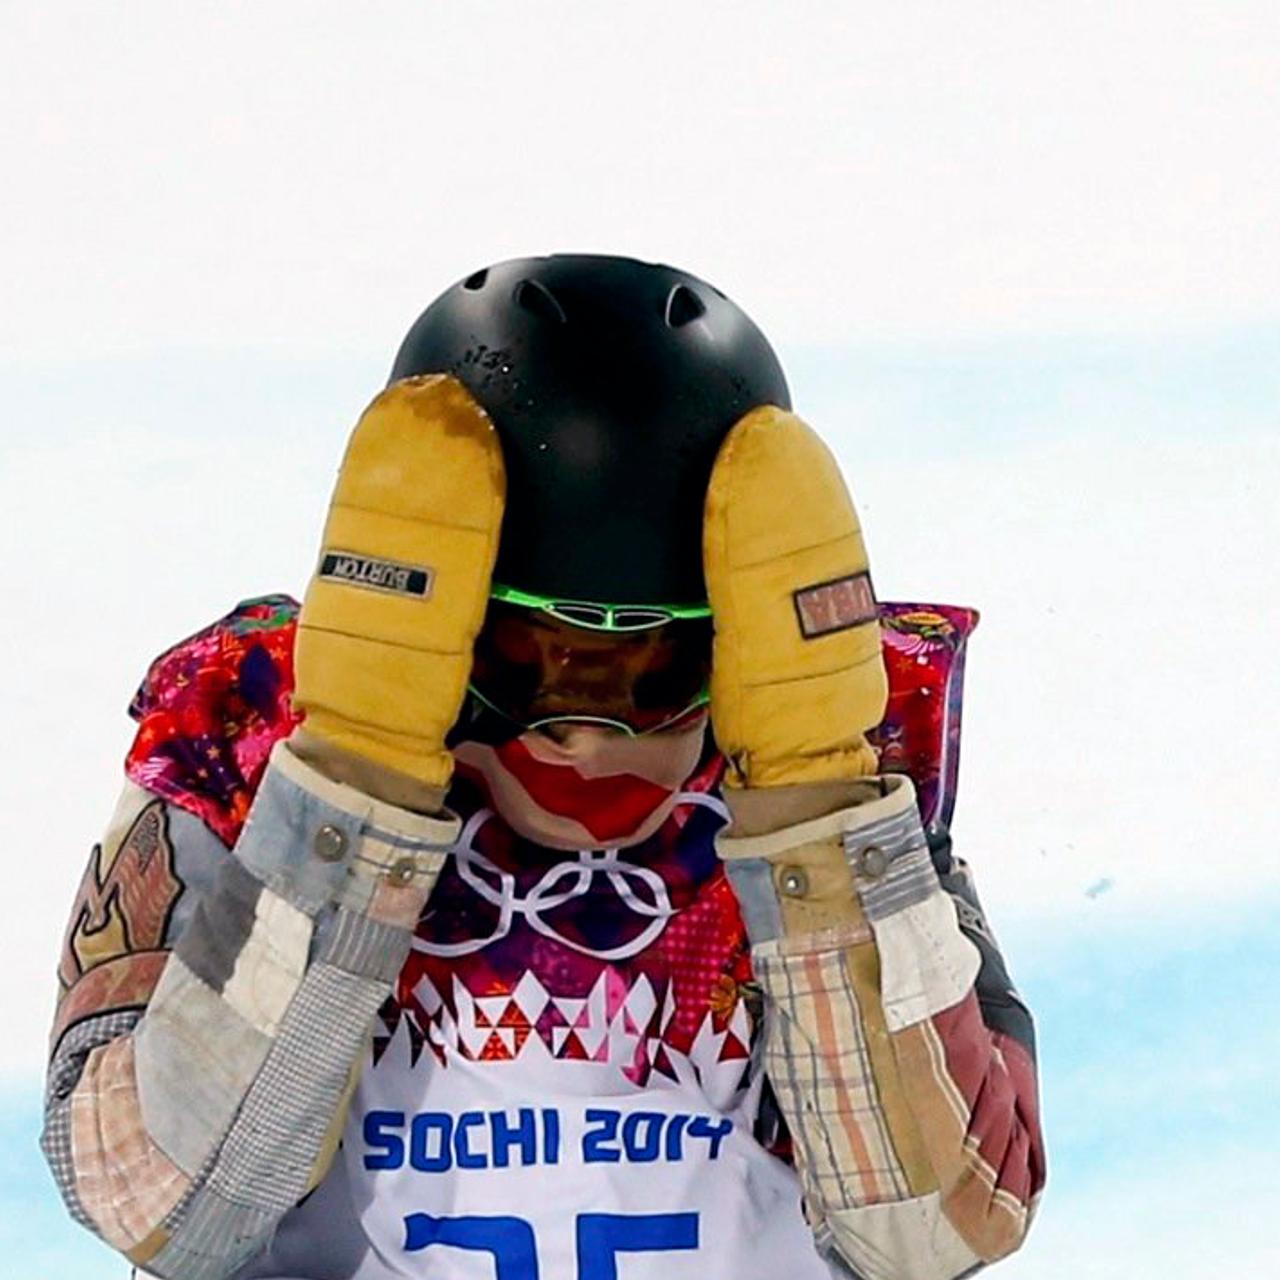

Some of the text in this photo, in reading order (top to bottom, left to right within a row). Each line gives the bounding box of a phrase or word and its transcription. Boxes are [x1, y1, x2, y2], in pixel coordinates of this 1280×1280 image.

[331, 557, 411, 591] BURTON
[363, 1109, 733, 1173] SOCHI 2014
